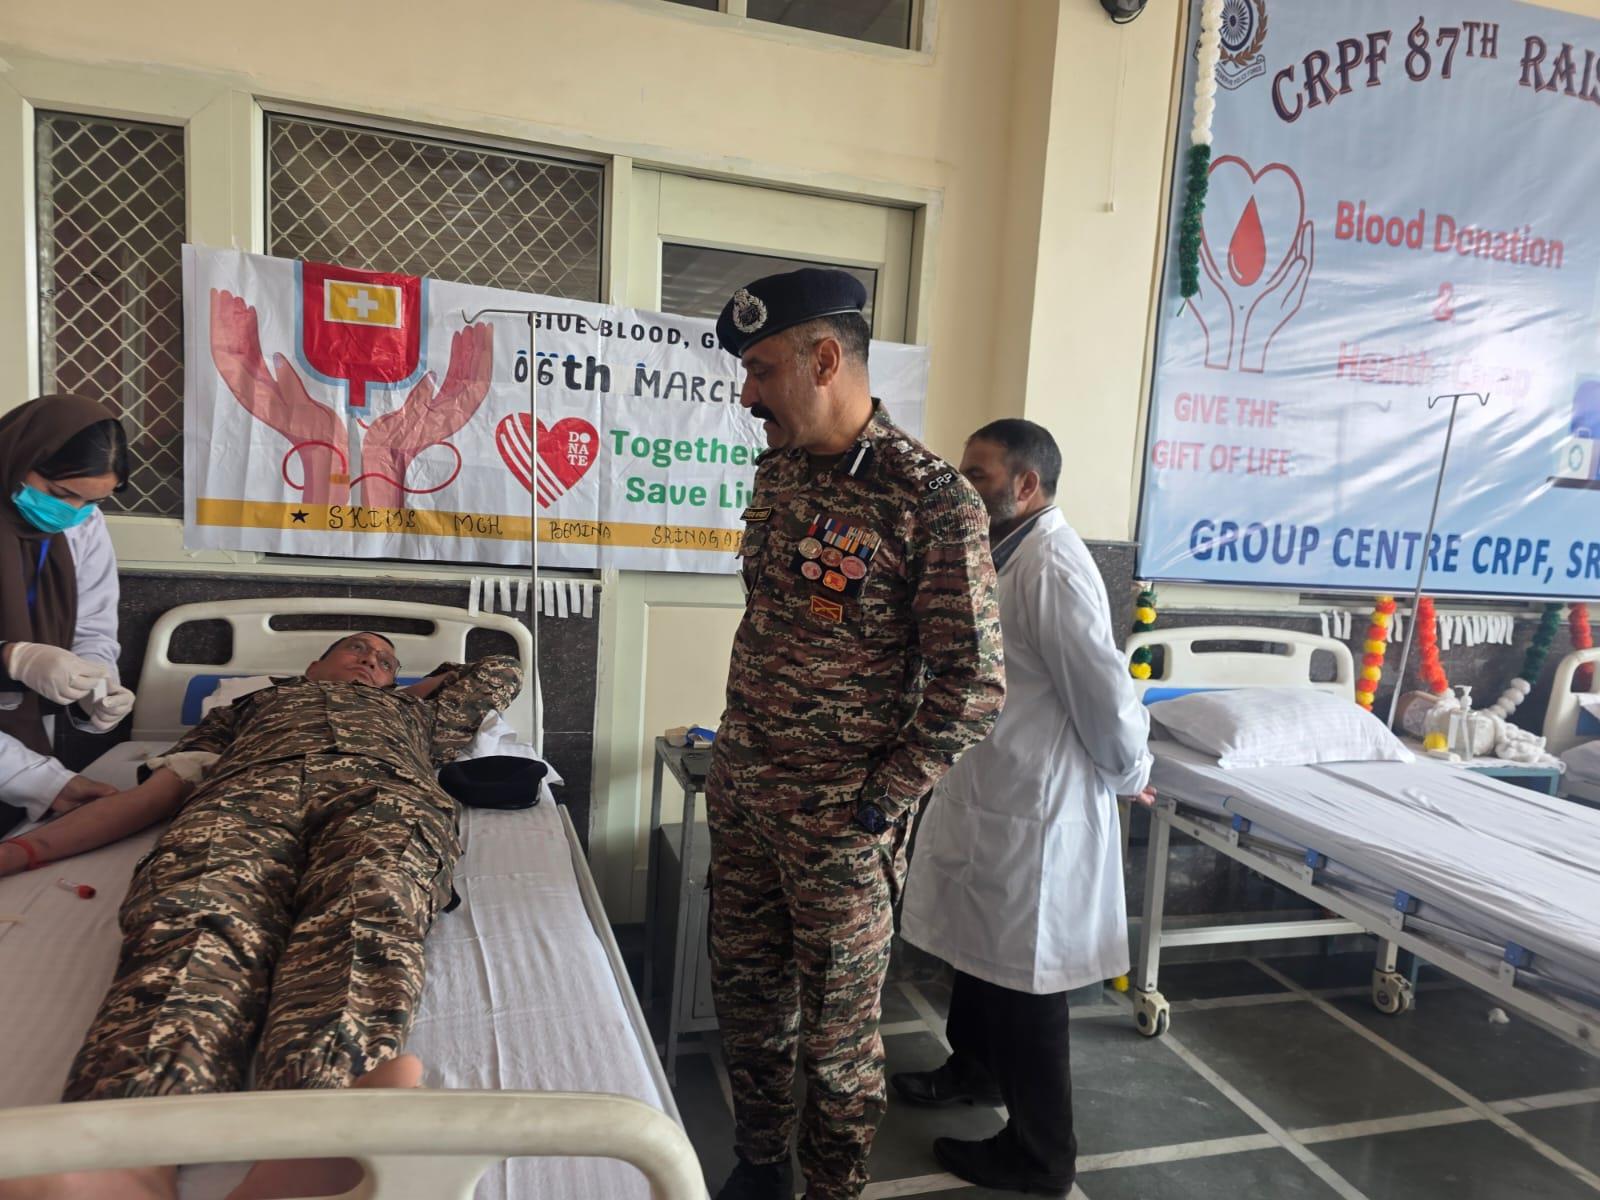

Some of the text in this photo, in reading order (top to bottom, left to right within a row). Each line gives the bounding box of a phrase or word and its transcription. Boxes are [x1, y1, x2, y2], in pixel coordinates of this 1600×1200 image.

[1272, 30, 1393, 123] CRPF
[1405, 16, 1500, 82] 87TH
[1335, 200, 1564, 268] Blood Donation
[600, 319, 689, 349] BLOOD,
[634, 366, 741, 404] MARCH
[1174, 392, 1281, 428] GIVE THE
[1152, 440, 1293, 476] GIFT OF LIFE
[625, 477, 707, 507] Save
[1190, 519, 1600, 584] GROUP CENTRE CRPF, SR
